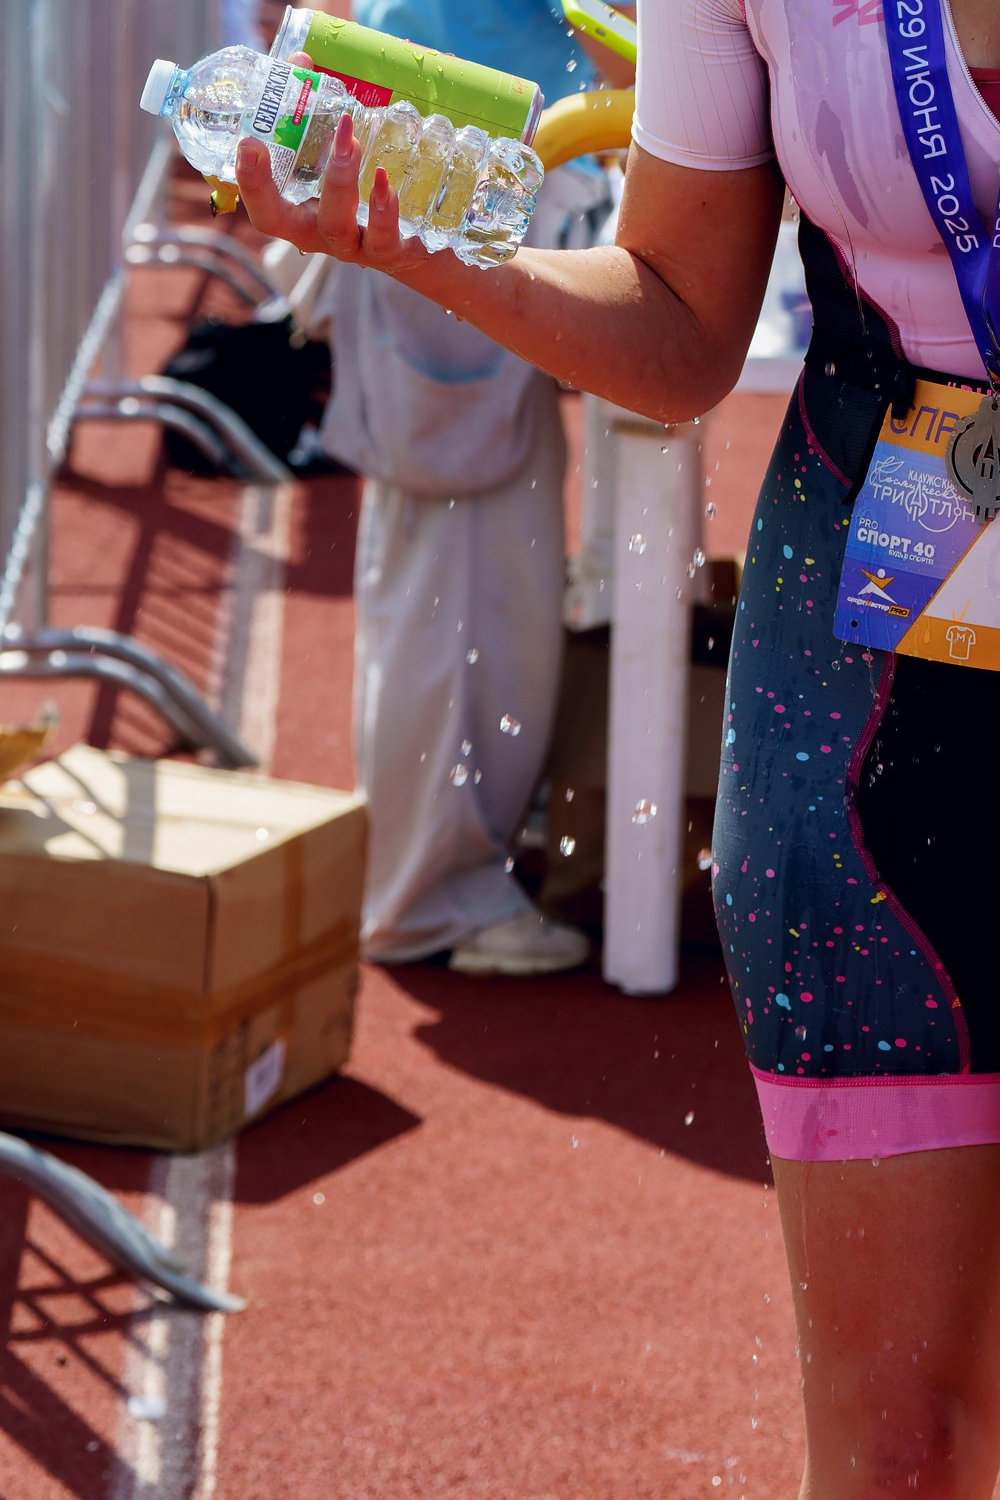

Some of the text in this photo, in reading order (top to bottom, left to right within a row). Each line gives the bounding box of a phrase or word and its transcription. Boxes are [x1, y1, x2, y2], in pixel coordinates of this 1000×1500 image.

[902, 45, 947, 160] ИЮНЯ
[930, 173, 980, 254] 2025
[858, 517, 879, 530] PRO
[857, 526, 936, 559] СПОРТ 40
